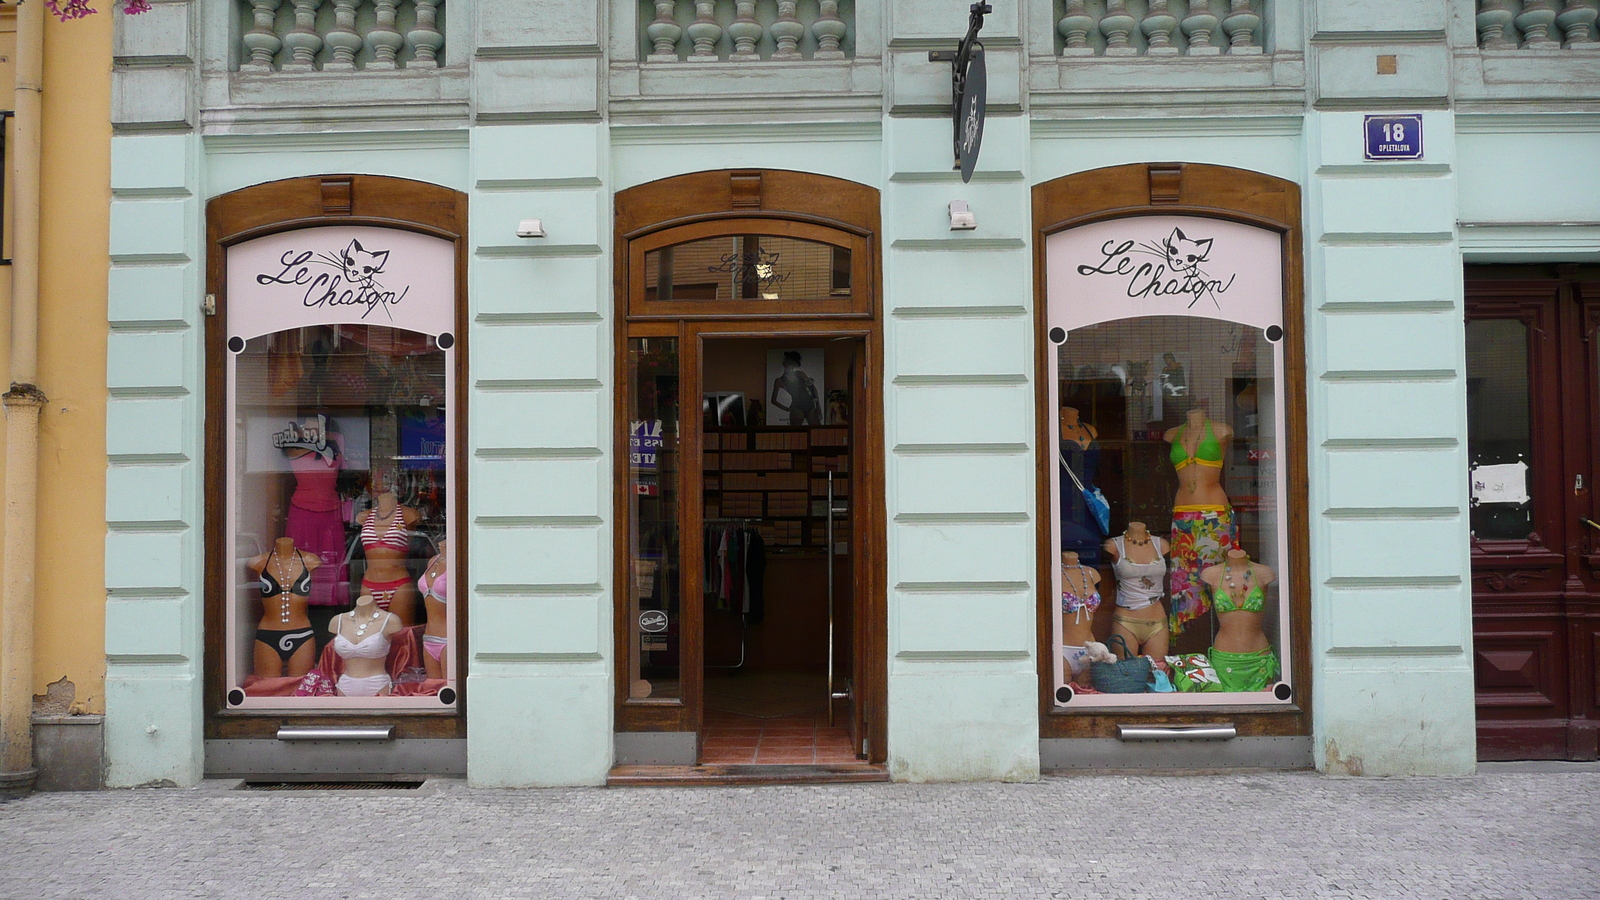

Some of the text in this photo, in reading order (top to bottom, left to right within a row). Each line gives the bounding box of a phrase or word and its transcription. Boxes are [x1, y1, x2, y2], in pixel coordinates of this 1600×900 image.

[1378, 144, 1410, 152] OPLETALOVA
[1383, 123, 1404, 142] 18
[257, 250, 312, 285] Le
[708, 253, 738, 272] Le
[1077, 239, 1135, 276] Le
[303, 273, 410, 316] Chaton
[1127, 262, 1236, 307] Chaton
